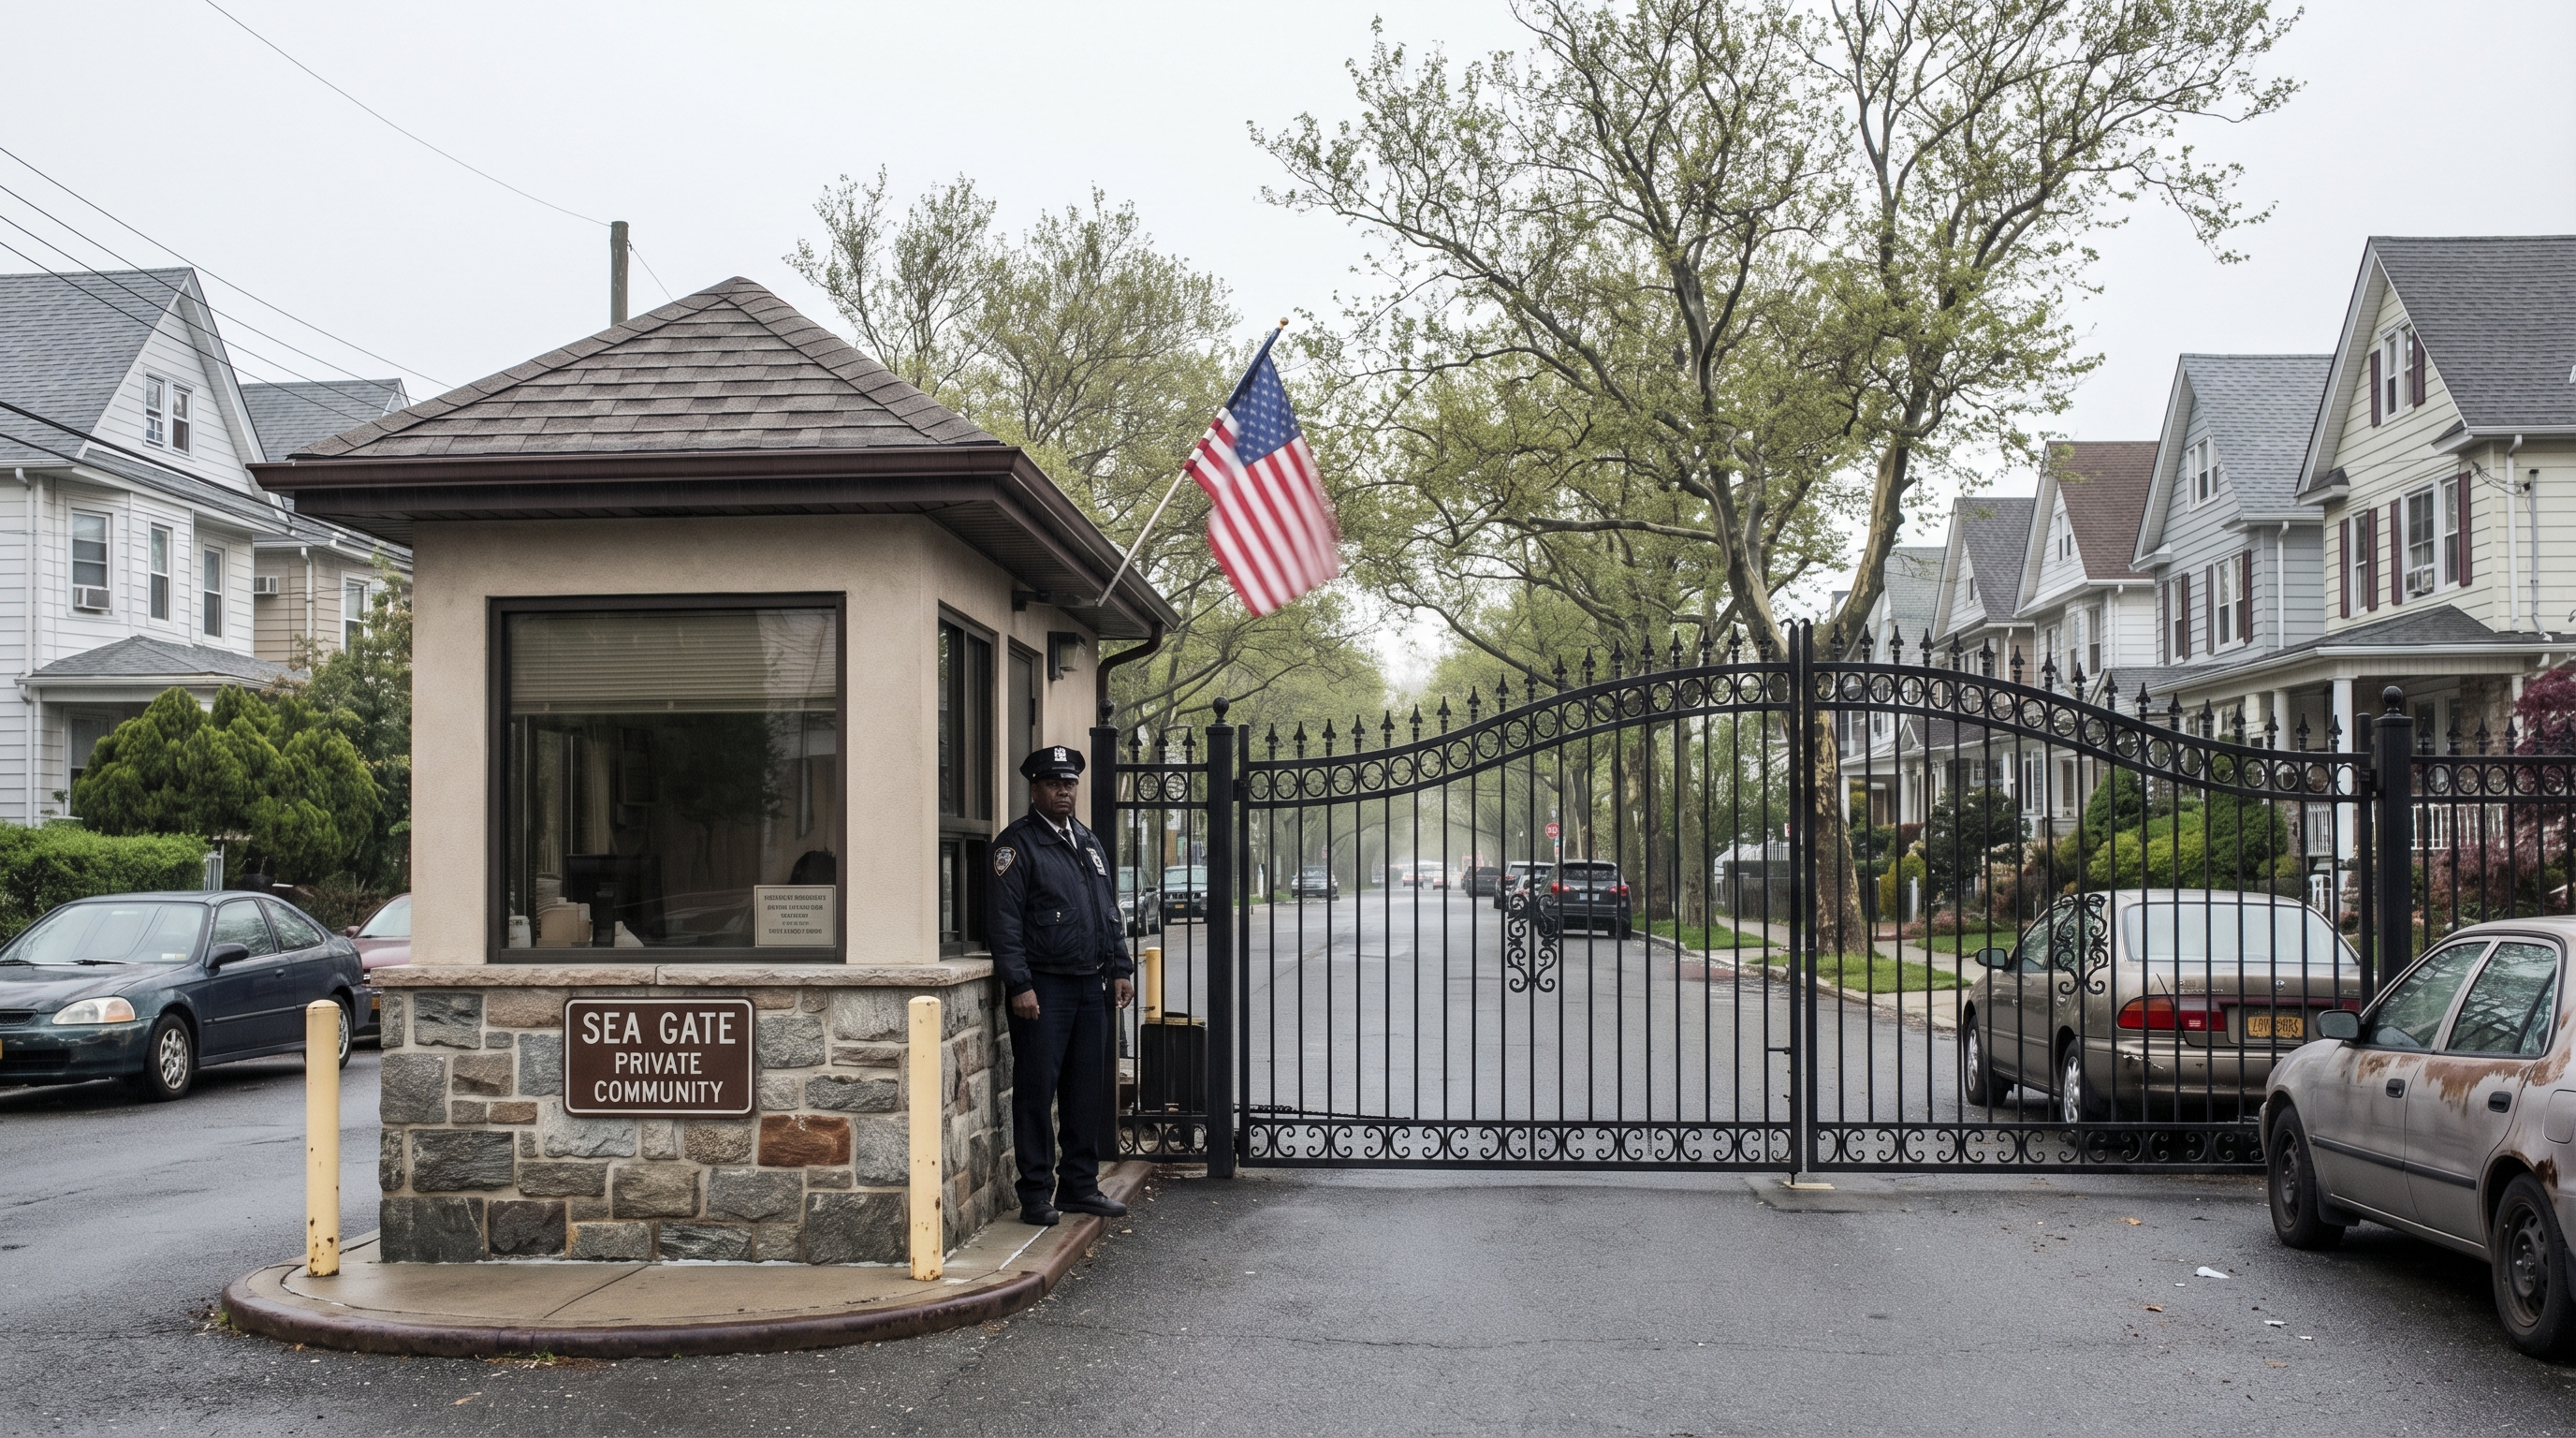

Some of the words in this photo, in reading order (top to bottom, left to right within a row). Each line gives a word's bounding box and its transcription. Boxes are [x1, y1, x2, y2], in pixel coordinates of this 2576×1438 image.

[581, 1011, 642, 1045] SEA
[659, 1011, 736, 1045] GATE
[615, 1051, 703, 1075] PRIVATE
[593, 1079, 724, 1104] COMMUNITY
